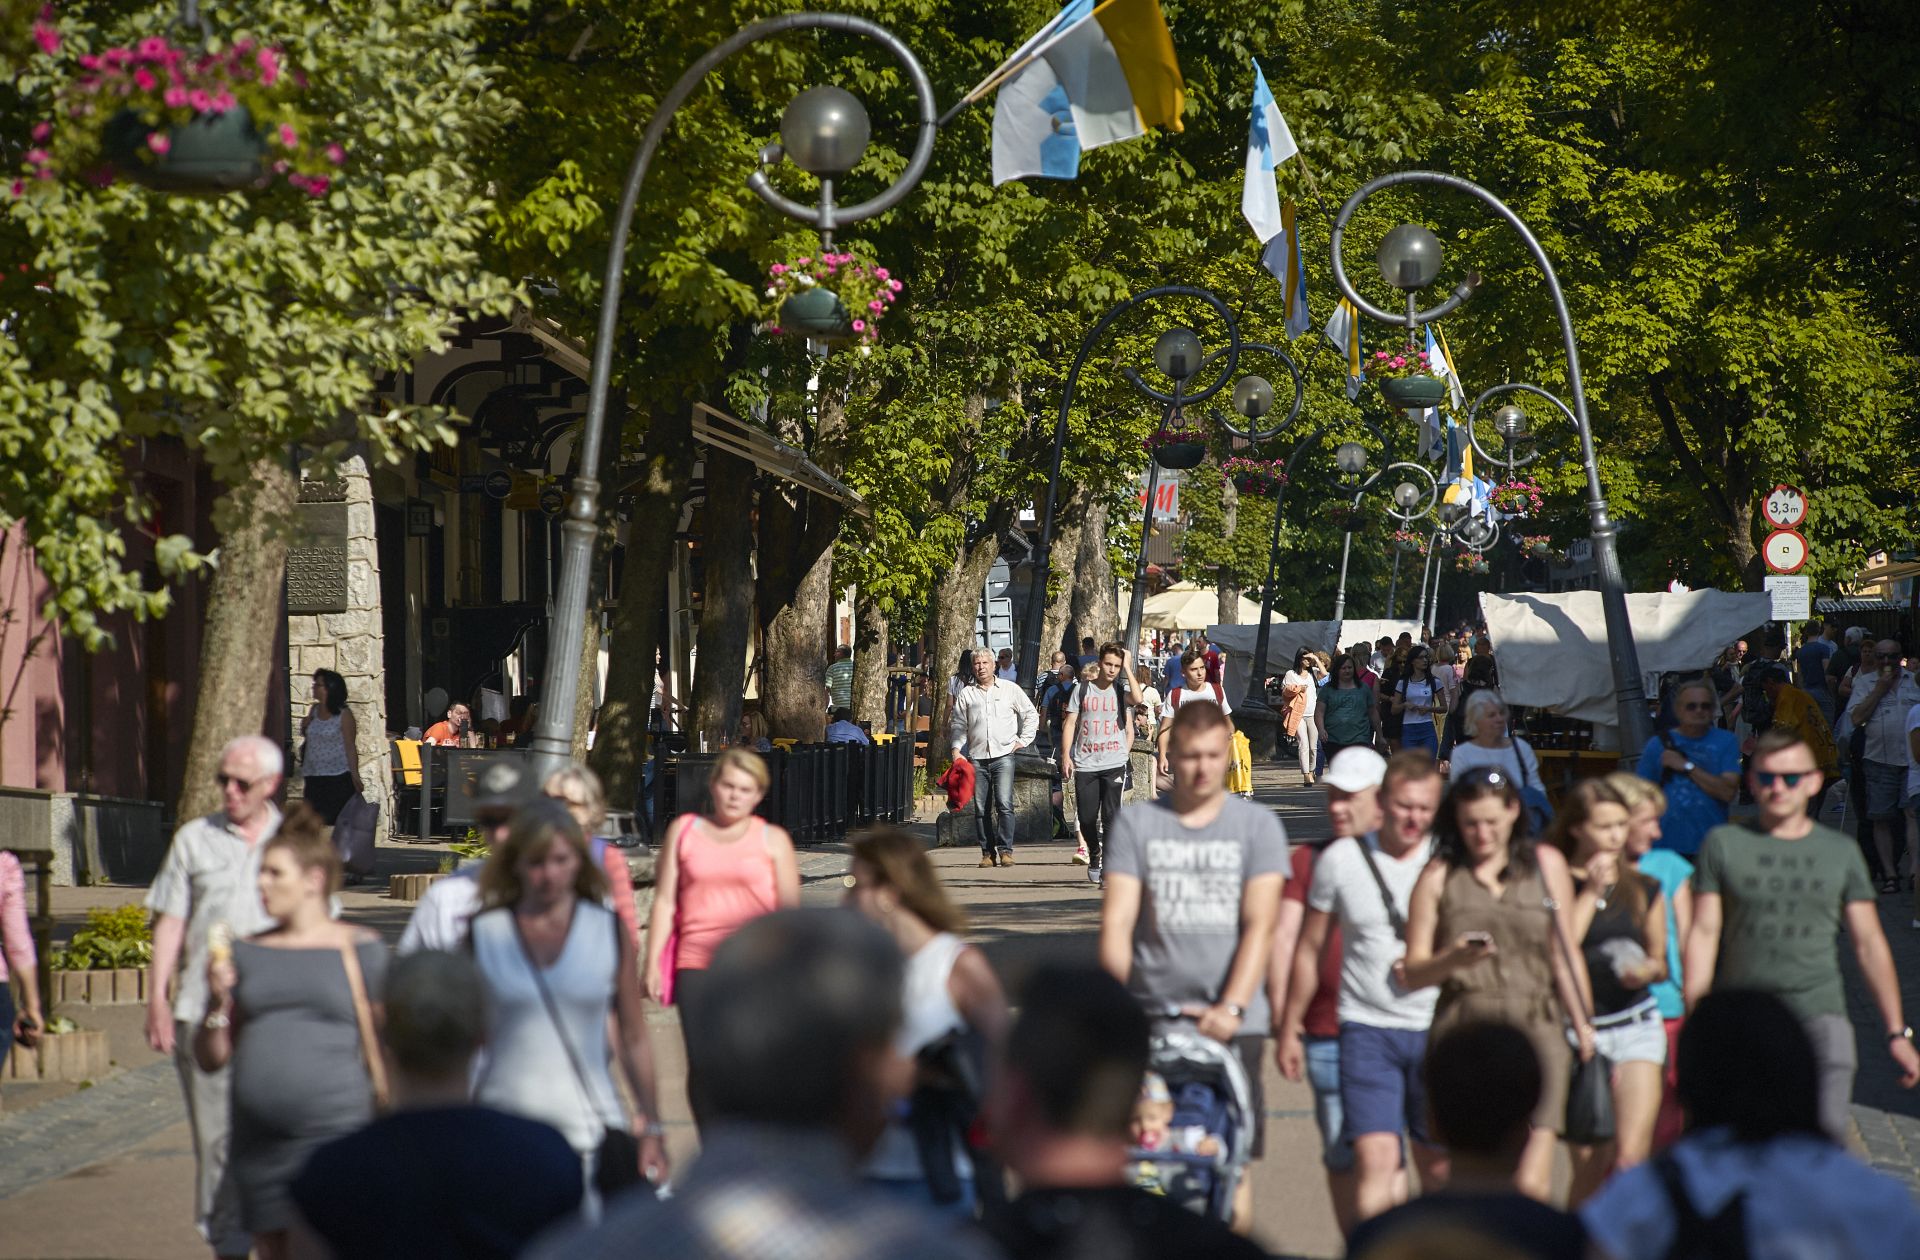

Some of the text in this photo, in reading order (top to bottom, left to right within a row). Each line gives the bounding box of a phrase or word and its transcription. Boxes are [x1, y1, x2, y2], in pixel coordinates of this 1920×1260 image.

[1147, 839, 1242, 869] DOMYOS
[1757, 854, 1817, 871] WHY
[1149, 871, 1242, 901] FITNESS
[1742, 875, 1825, 893] WORK
